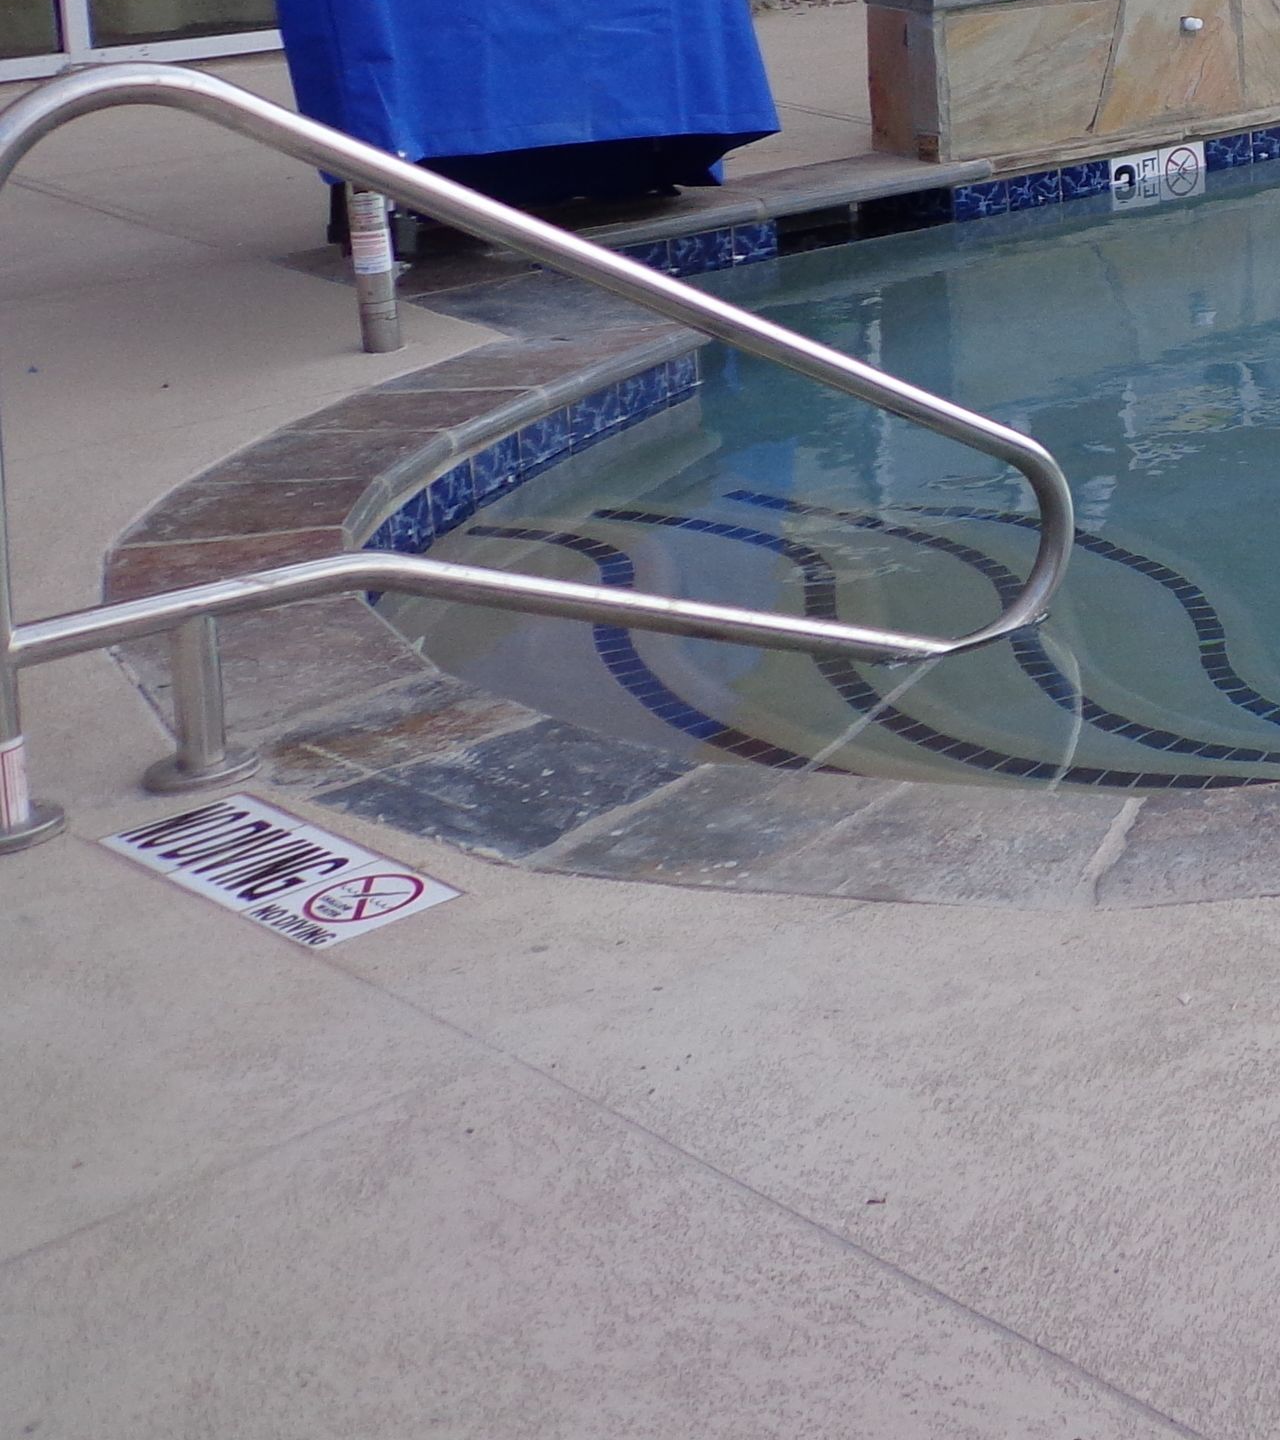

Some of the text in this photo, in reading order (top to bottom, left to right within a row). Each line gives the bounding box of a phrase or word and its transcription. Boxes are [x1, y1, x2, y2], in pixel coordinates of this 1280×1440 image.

[1142, 157, 1157, 173] FT
[118, 802, 350, 902] NO DIVING
[249, 903, 337, 945] NO DIVING
